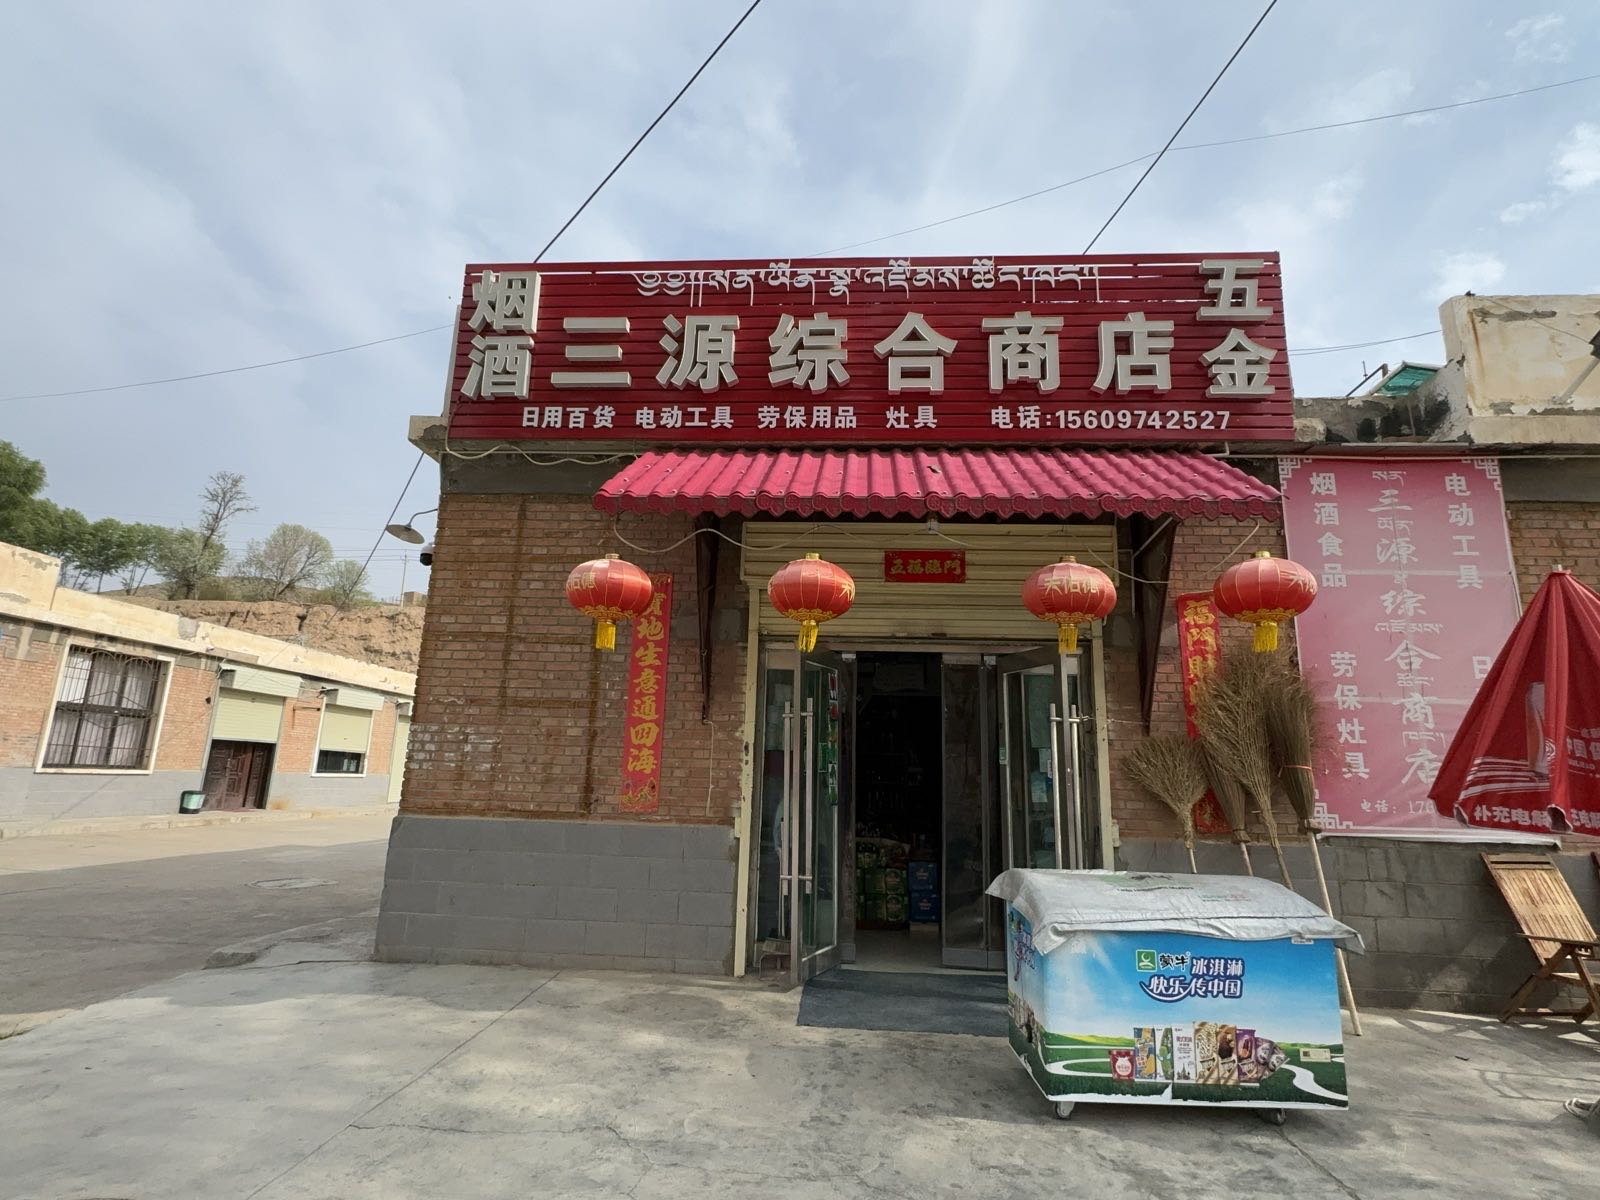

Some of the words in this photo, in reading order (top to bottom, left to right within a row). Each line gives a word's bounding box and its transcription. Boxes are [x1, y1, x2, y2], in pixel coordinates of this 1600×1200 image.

[460, 269, 541, 400] 烟酒
[551, 311, 1175, 395] 三源综合商店
[1196, 259, 1278, 398] 五金
[522, 406, 616, 428] 日用百货
[635, 405, 734, 429] 电动工具
[757, 405, 857, 429] 劳保用品
[885, 405, 938, 430] 灶具
[566, 571, 600, 592] 佑德
[1310, 472, 1348, 588] 烟酒食品
[1445, 473, 1483, 590] 电动工具
[1368, 489, 1441, 785] 三源综合商店
[1330, 651, 1370, 780] 劳保灶具
[1147, 976, 1242, 998] 快乐传中国
[1159, 953, 1189, 971] 蒙牛
[1191, 957, 1244, 977] 冰淇淋
